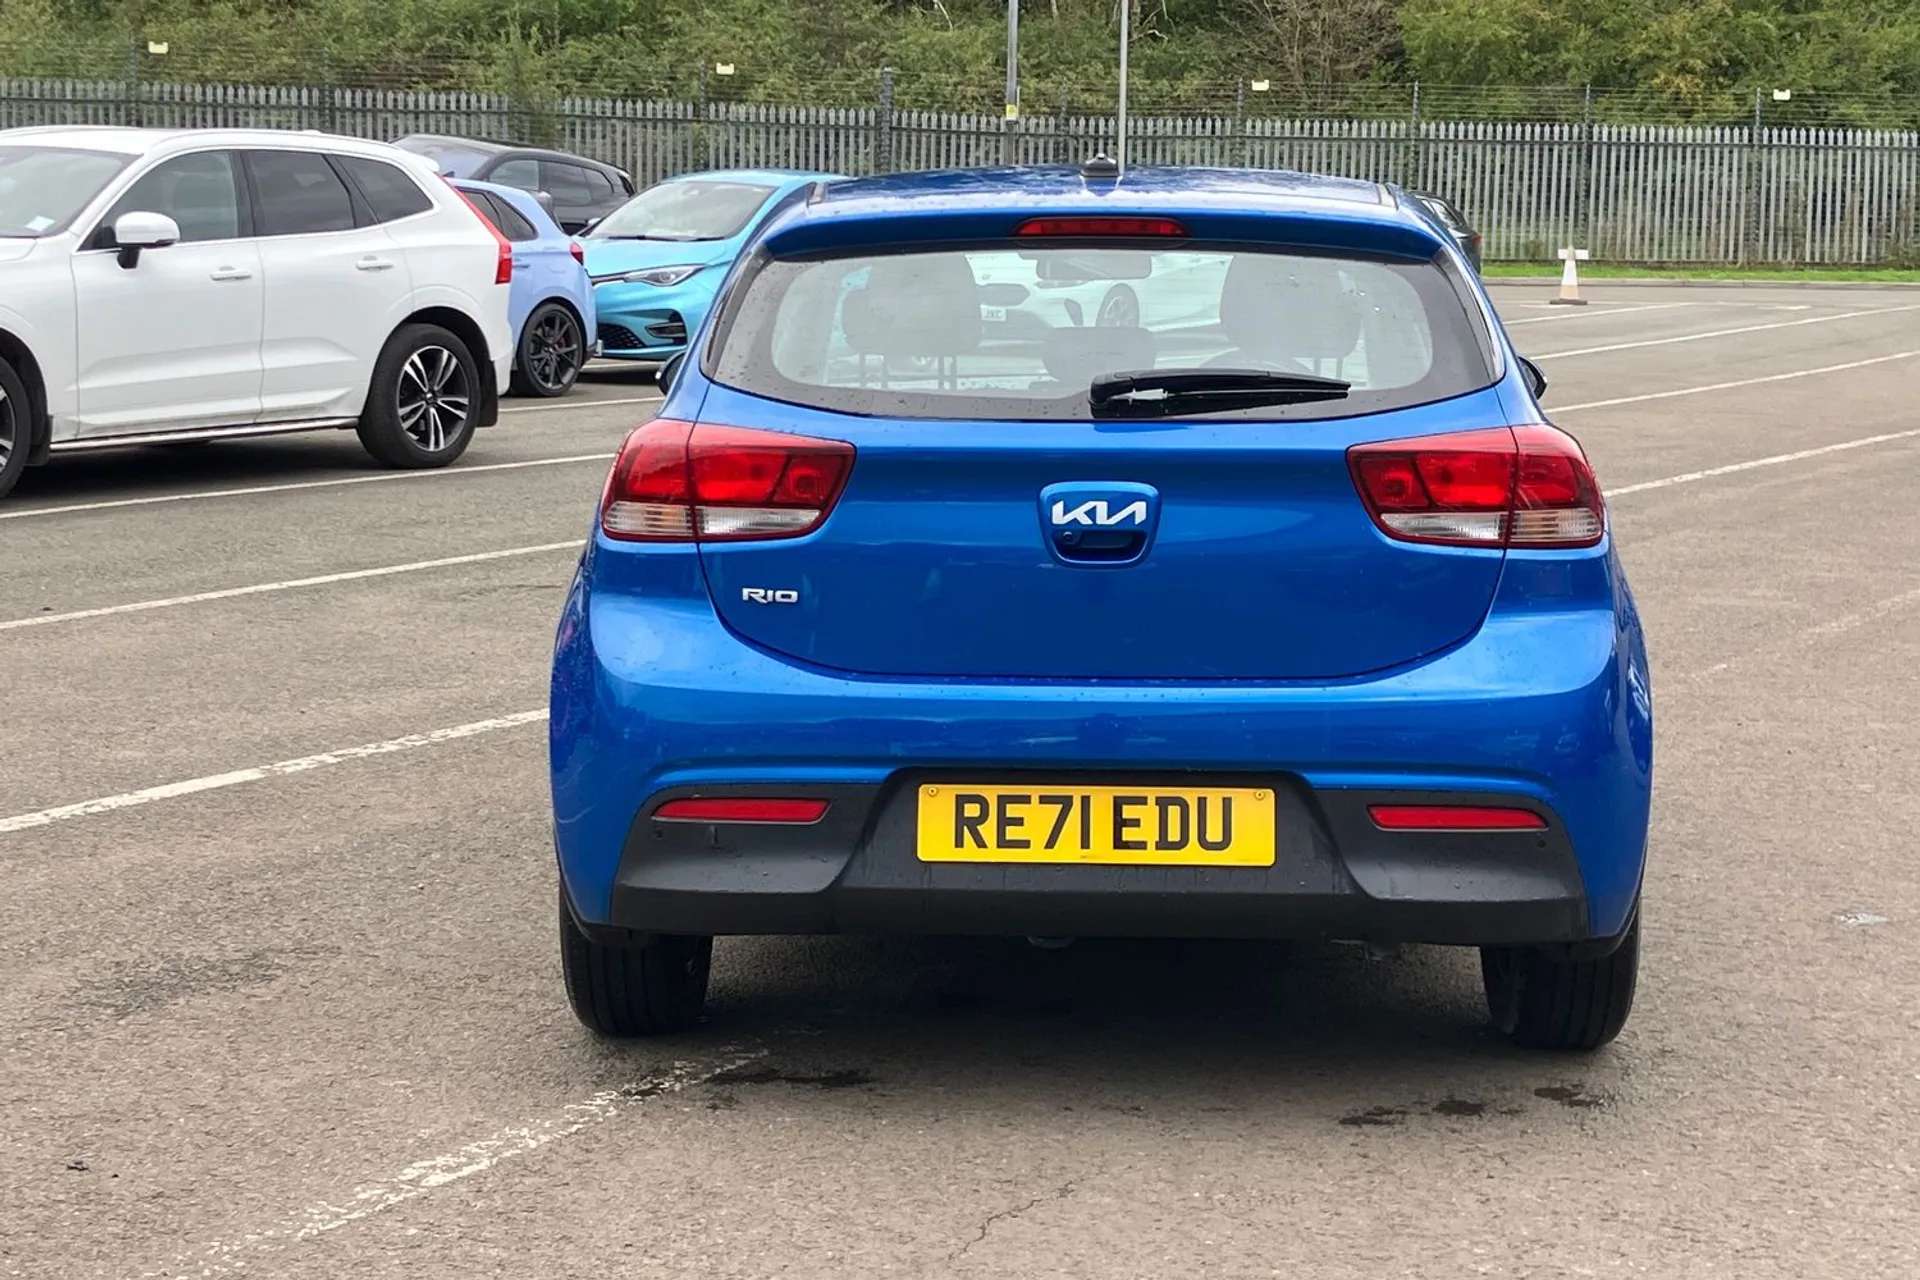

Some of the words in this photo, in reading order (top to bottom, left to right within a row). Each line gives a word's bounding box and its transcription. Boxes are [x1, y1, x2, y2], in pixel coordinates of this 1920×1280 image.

[1052, 500, 1146, 525] KIA
[742, 587, 798, 603] RIO
[954, 794, 1091, 849] RE71
[1113, 795, 1232, 851] EDU
